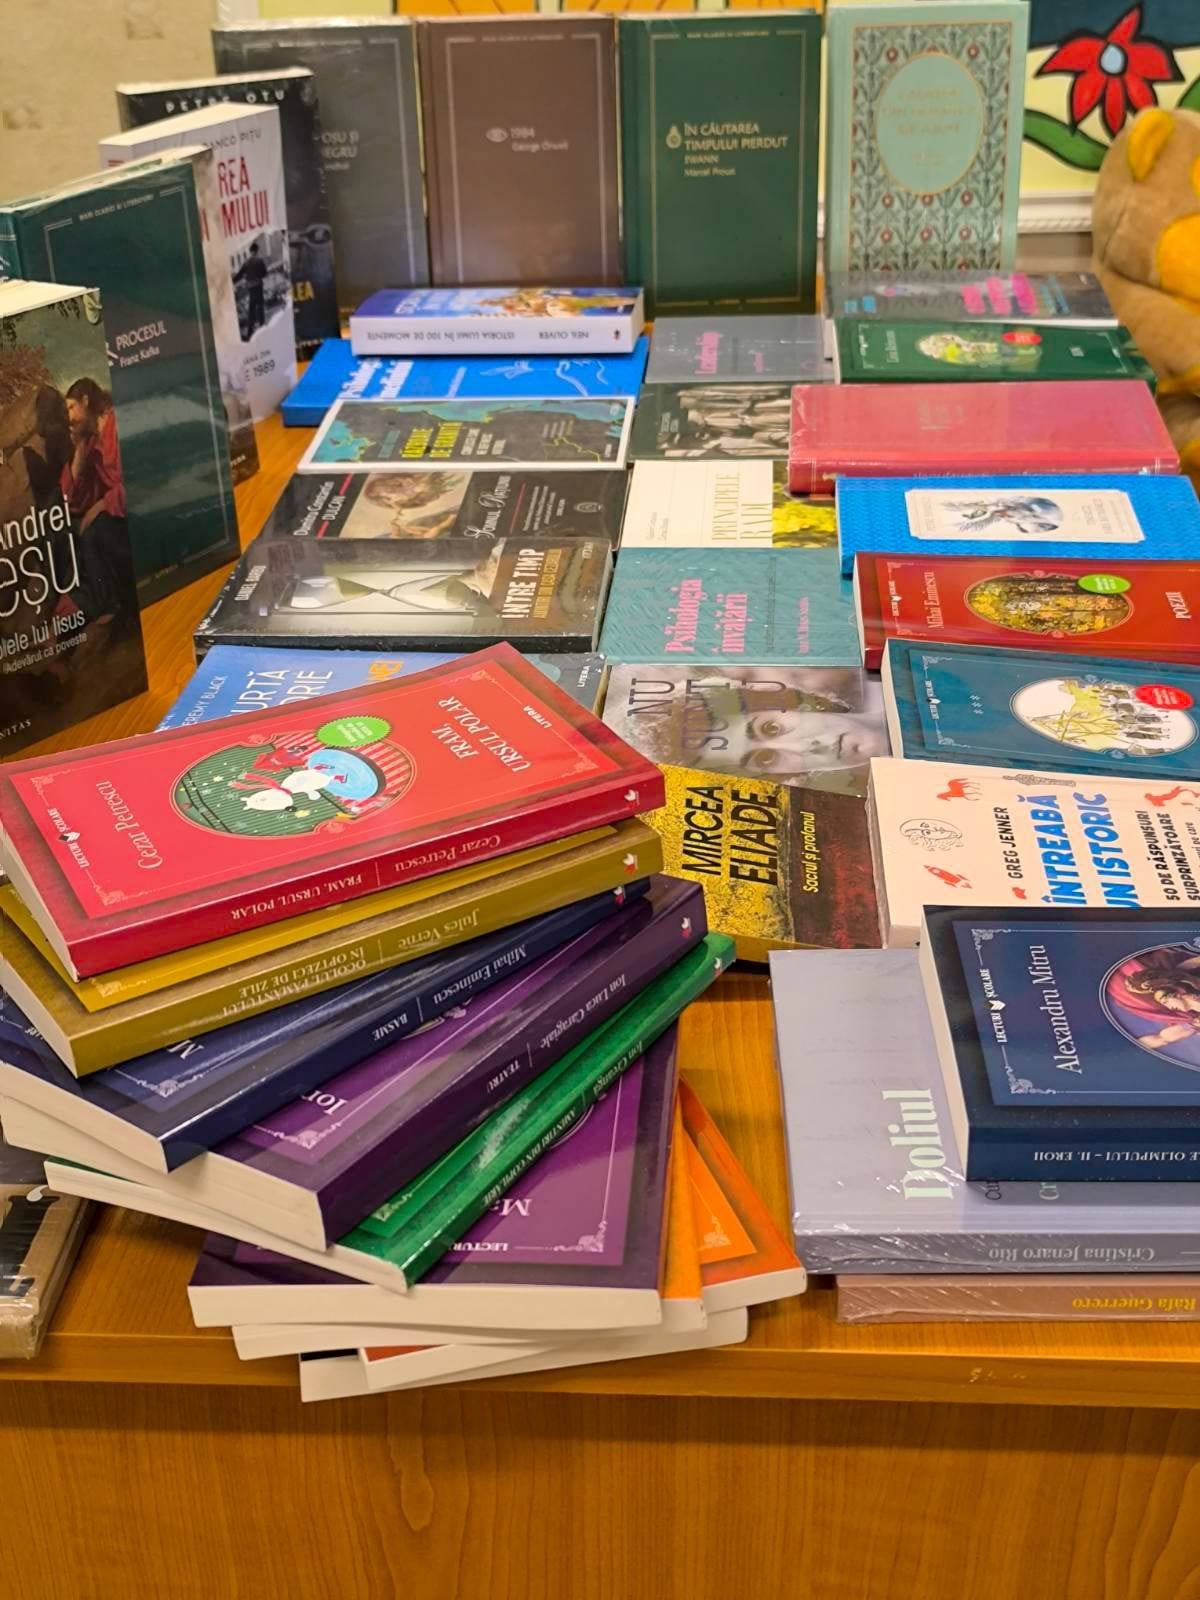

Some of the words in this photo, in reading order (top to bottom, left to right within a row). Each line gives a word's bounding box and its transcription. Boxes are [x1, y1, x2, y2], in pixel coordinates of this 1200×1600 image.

[510, 127, 536, 139] 1984
[684, 139, 739, 151] TIMPULUI
[741, 136, 789, 150] PIERDUT
[700, 121, 761, 137] CĂUTAREA
[115, 320, 168, 351] PROCESUL
[538, 331, 570, 341] OLIVER
[321, 495, 347, 521] DULCAN
[712, 472, 741, 541] PRINCIPELE
[515, 548, 545, 579] TIMP
[923, 571, 942, 606] Eminescu
[664, 578, 708, 653] Psihologia
[924, 605, 945, 630] Mihai
[1165, 591, 1192, 620] POEZII
[33, 620, 50, 647] lui
[53, 609, 86, 637] Iisus
[56, 631, 88, 654] poveste
[207, 675, 229, 700] BLACK
[577, 665, 590, 688] LITERA
[627, 678, 676, 718] NU
[438, 695, 489, 735] POLAR
[522, 704, 553, 729] LITERA
[432, 723, 480, 760] FRAM,
[479, 735, 532, 773] URSUL
[96, 780, 140, 833] Petrescu
[681, 786, 724, 877] MIRCEA
[729, 788, 780, 887] ELIADE
[798, 811, 822, 851] profanul
[993, 806, 1017, 849] JENNER
[1073, 791, 1133, 879] ISTORIC
[1135, 810, 1169, 871] RĂSPUNSURI
[127, 831, 163, 870] Cezar
[462, 834, 502, 854] Cezar
[802, 850, 820, 861] și
[1016, 794, 1088, 906] ÎNTREABĂ
[1156, 813, 1200, 901] SURPRINZĂTOARE
[395, 847, 457, 873] Petrescu
[999, 850, 1024, 880] GREG
[803, 860, 820, 894] Sacrul
[1157, 872, 1175, 886] DE
[280, 886, 322, 907] URSUL
[1163, 887, 1181, 901] 50
[231, 900, 275, 921] POLAR
[444, 908, 480, 931] Jules
[398, 928, 442, 950] Verne
[292, 953, 349, 980] OPTZECI
[494, 944, 528, 978] Mihai
[1029, 943, 1057, 986] Mitru
[237, 979, 269, 998] ZILE
[272, 970, 290, 984] DE
[433, 963, 492, 1005] Eminescu
[608, 973, 627, 994] Ion
[980, 967, 997, 999] ȘCOLARE
[585, 987, 610, 1013] Luca
[372, 1012, 409, 1042] BASME
[539, 1008, 586, 1049] Caragiale
[991, 1011, 1008, 1044] LECTURI
[1040, 989, 1083, 1075] Alexandru
[487, 1059, 521, 1094] TEATRU
[1033, 1151, 1073, 1162] EROII
[1105, 1151, 1186, 1162] OLIMPULUI
[1022, 1244, 1081, 1262] Jenaro
[1084, 1246, 1155, 1263] Cristina
[1071, 1298, 1153, 1312] Guerrero
[1157, 1297, 1197, 1313] Rafa
